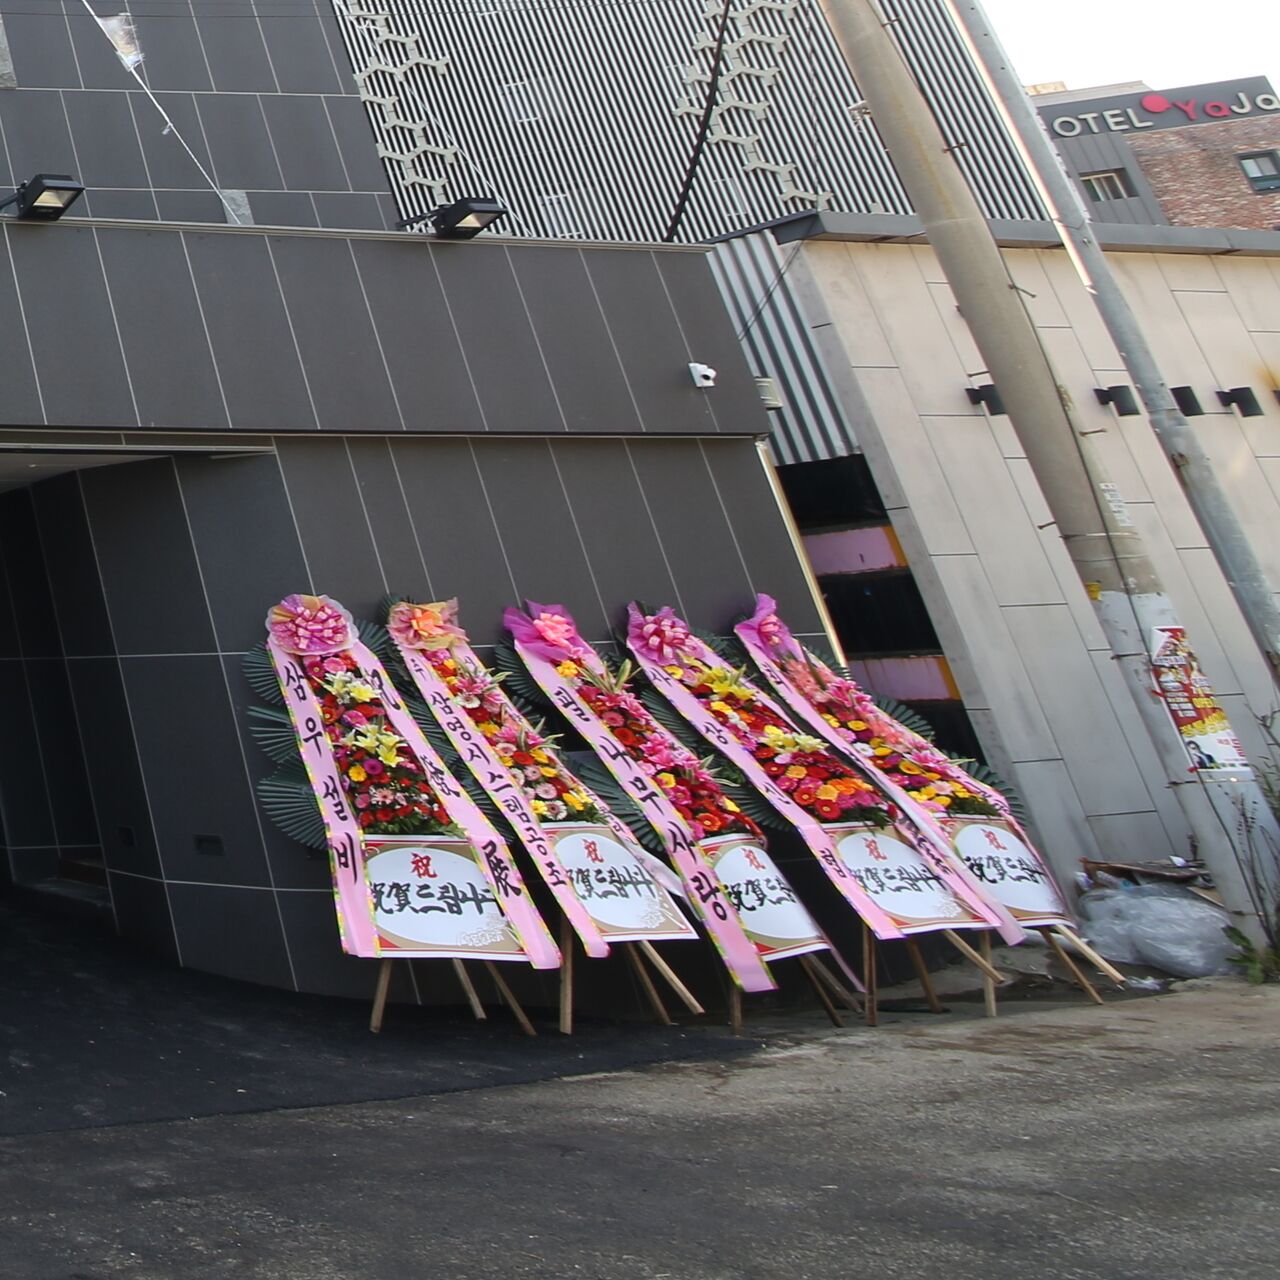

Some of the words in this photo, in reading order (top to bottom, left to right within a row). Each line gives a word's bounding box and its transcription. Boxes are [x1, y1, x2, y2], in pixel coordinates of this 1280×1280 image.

[1051, 106, 1154, 137] OTEL
[282, 660, 359, 885] 삼우설비
[583, 838, 604, 864] 祝
[864, 836, 888, 861] 祝
[981, 828, 1008, 851] 祝
[410, 852, 439, 879] 祝
